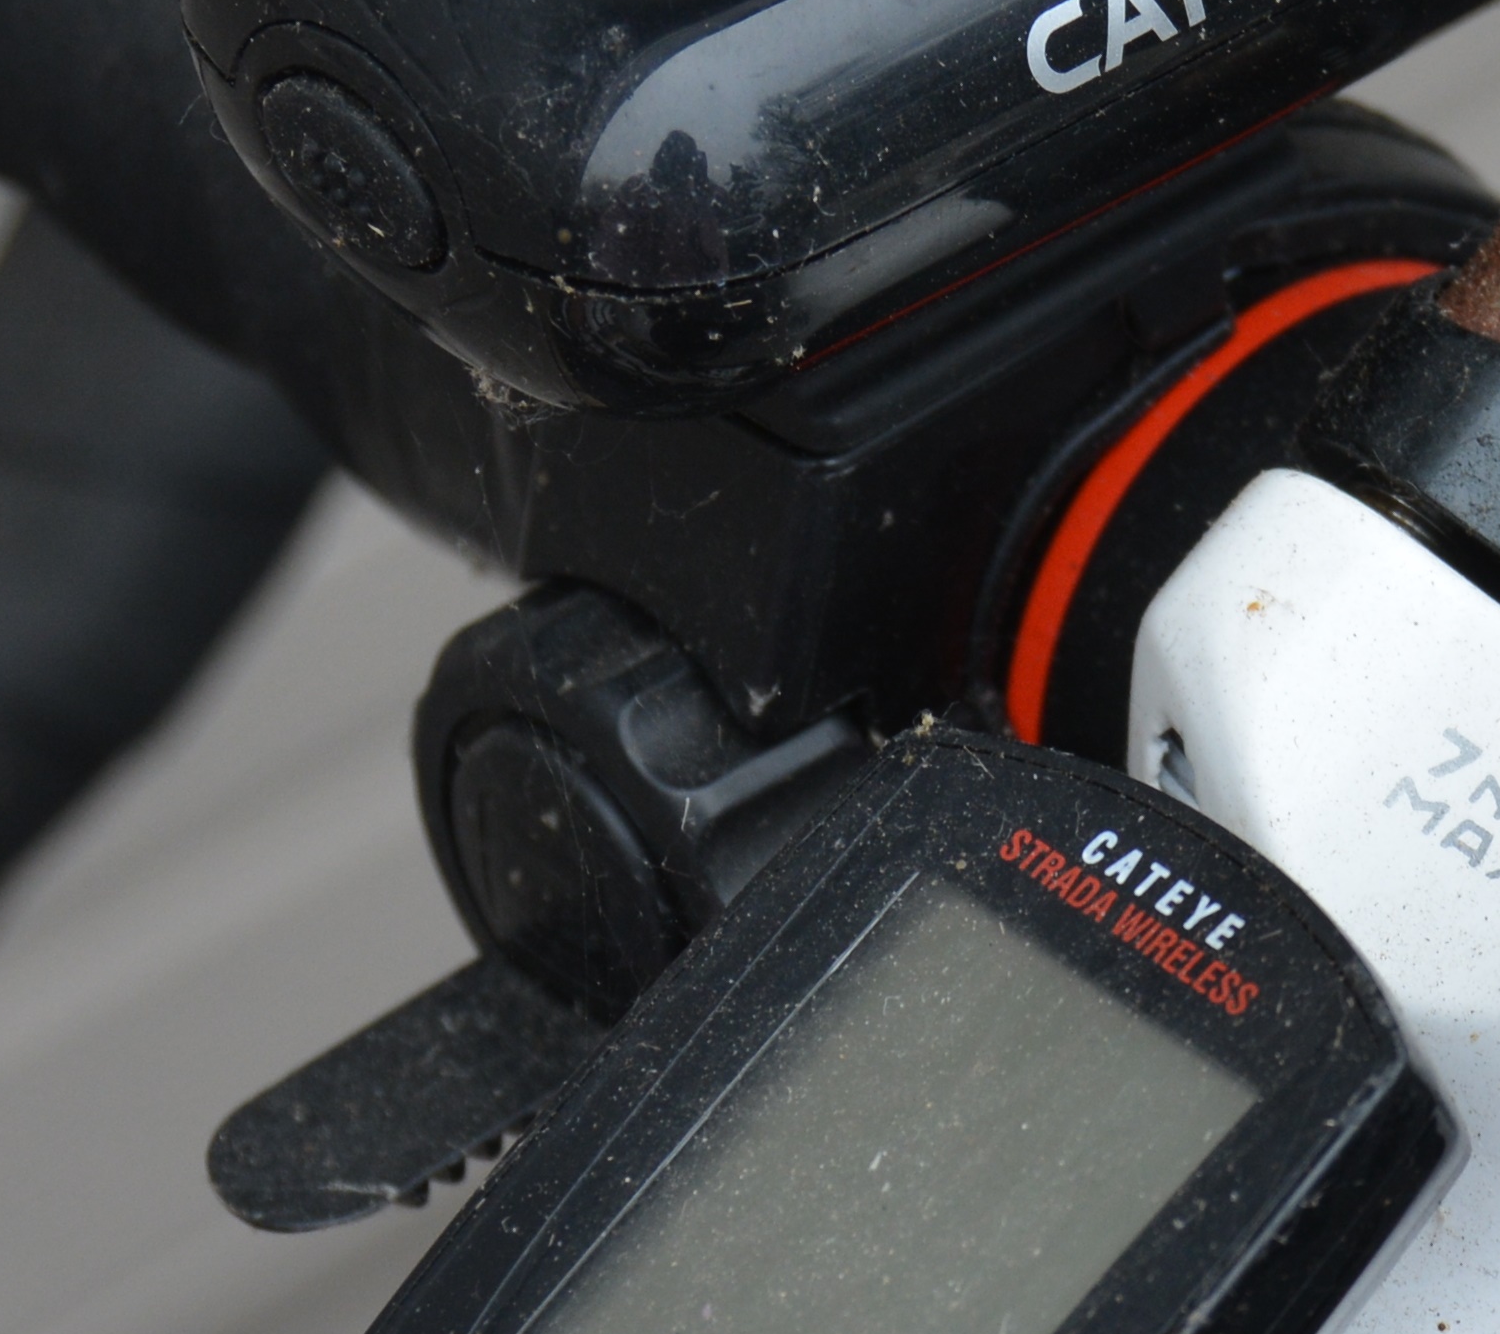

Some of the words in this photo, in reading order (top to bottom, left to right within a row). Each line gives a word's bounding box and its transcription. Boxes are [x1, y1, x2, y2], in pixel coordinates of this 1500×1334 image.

[999, 829, 1119, 923] STRADA
[1112, 904, 1260, 1016] WIRELESS
[1081, 830, 1246, 950] CATEYE
